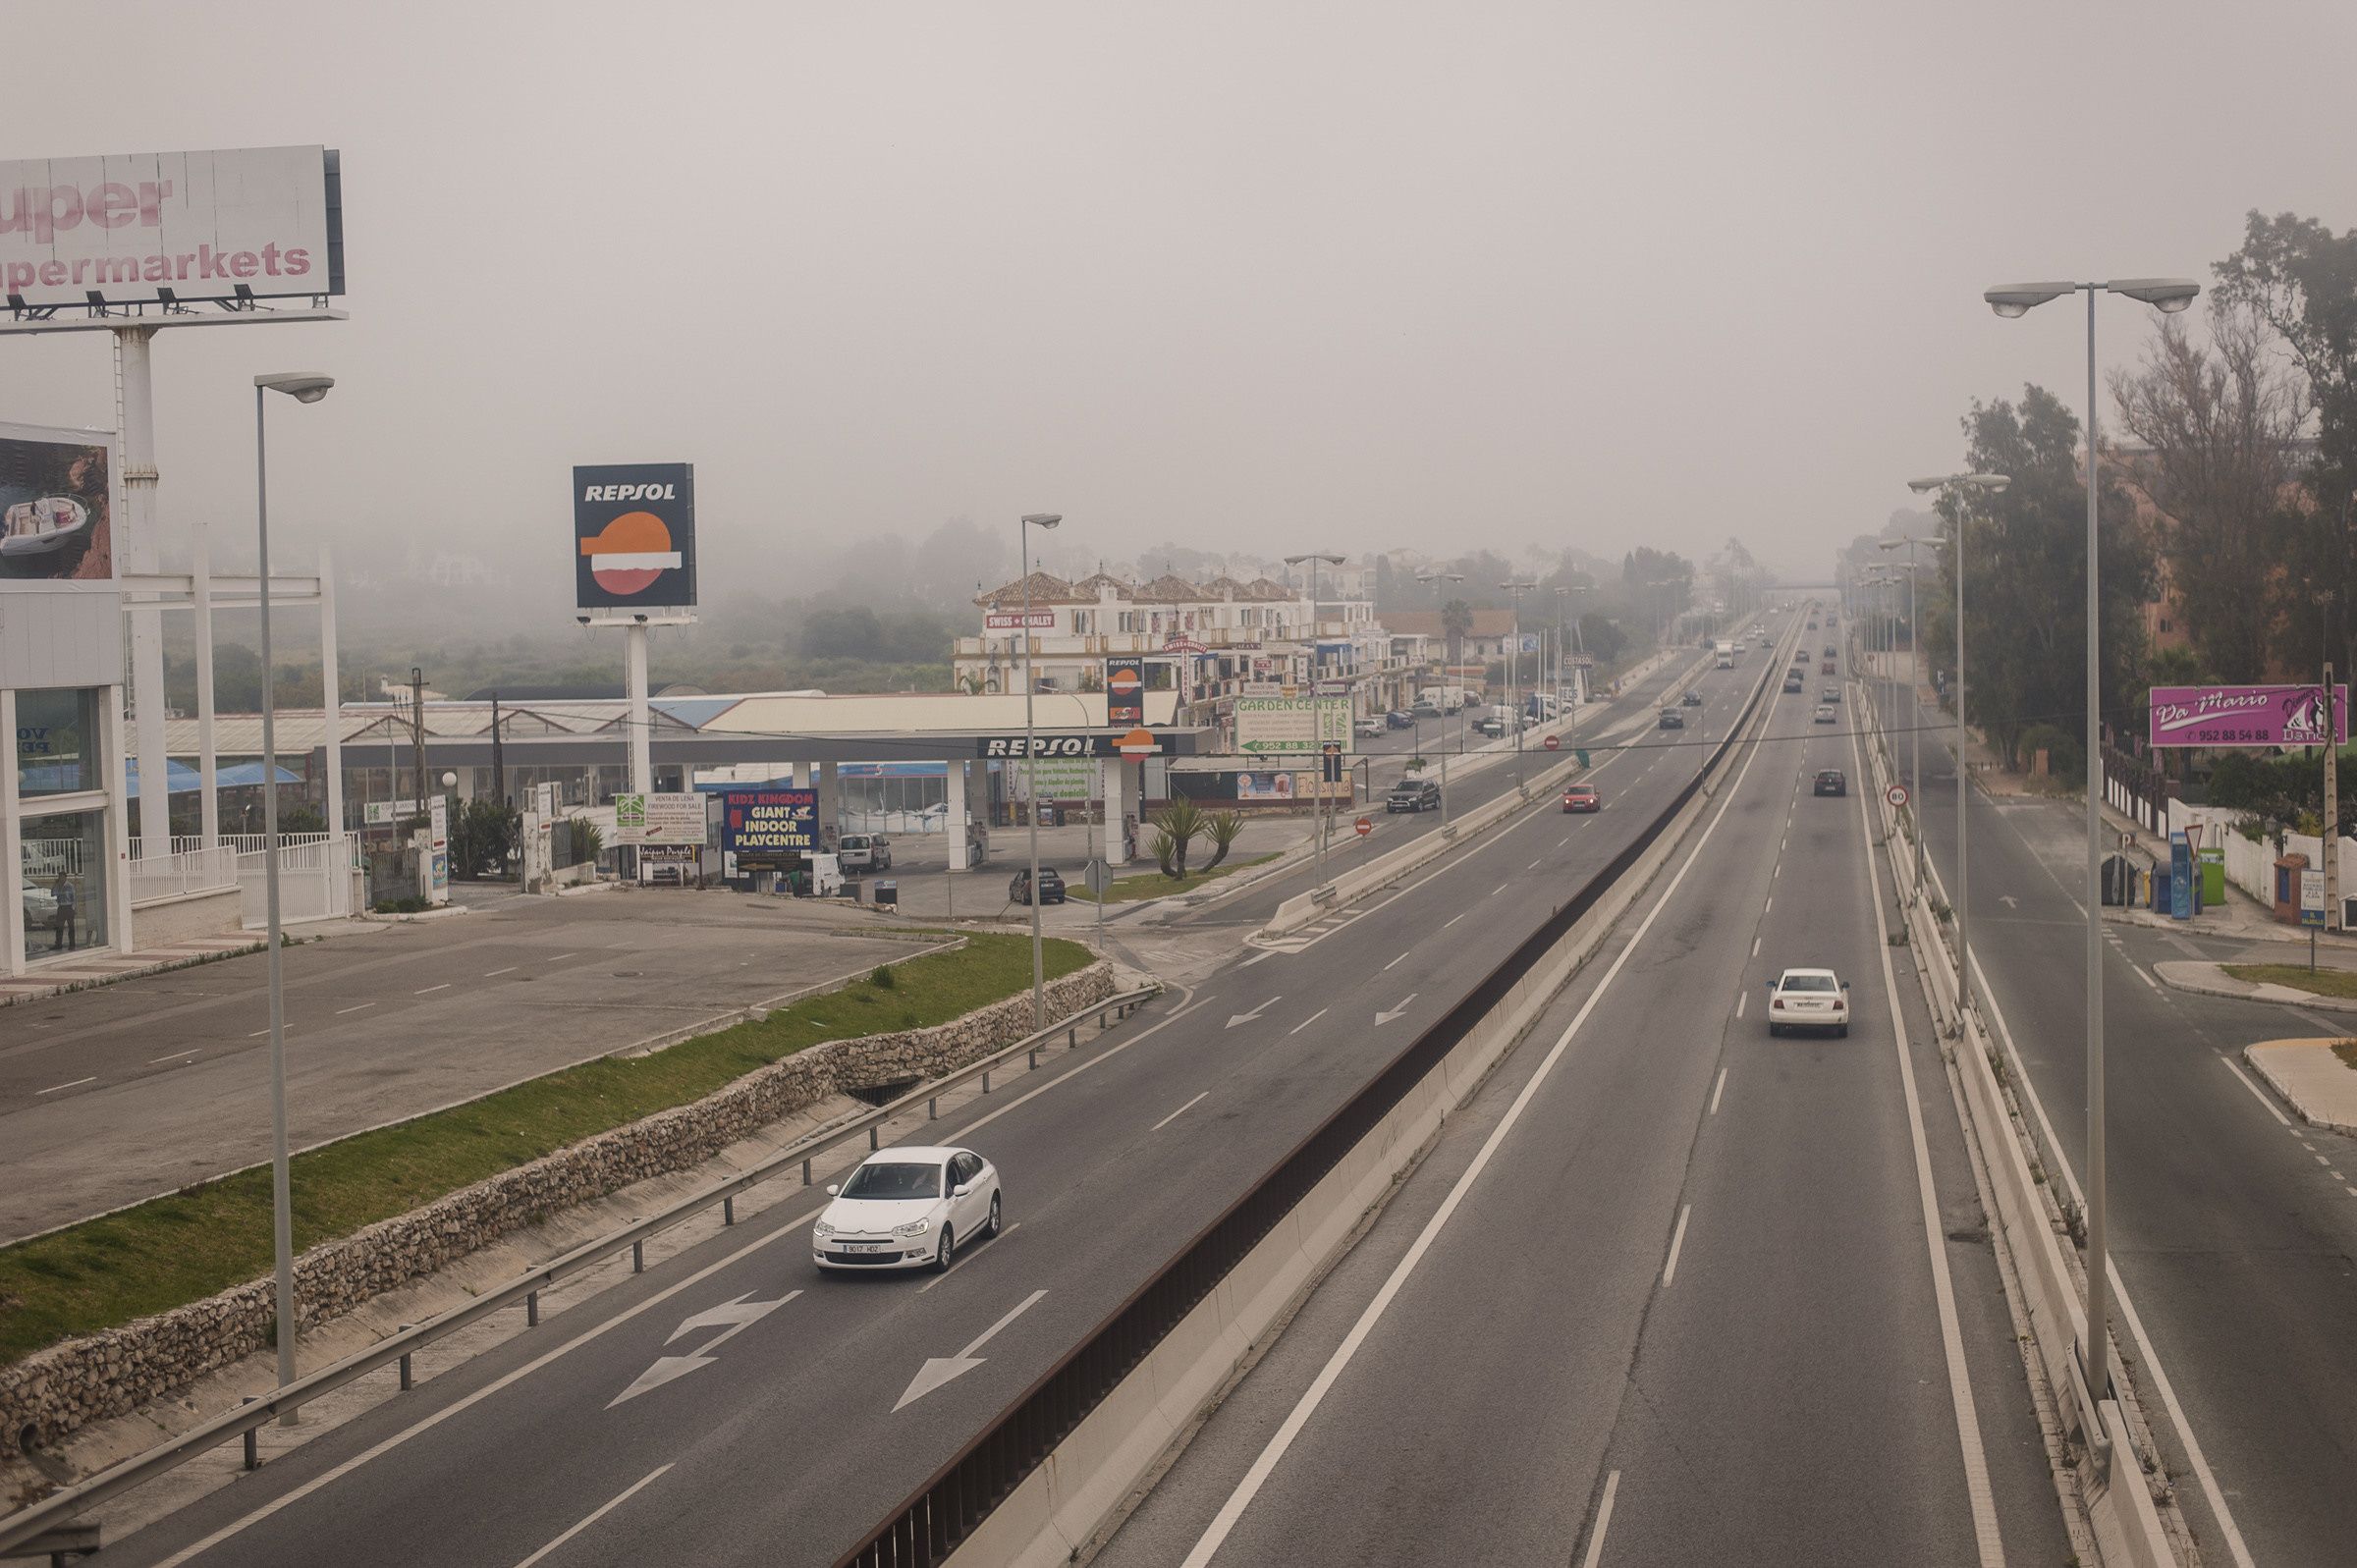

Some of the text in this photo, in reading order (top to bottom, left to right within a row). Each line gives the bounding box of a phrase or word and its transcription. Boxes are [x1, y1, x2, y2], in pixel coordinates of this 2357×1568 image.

[0, 242, 310, 296] permarkets
[584, 484, 676, 502] REPSOL
[989, 617, 1013, 627] SWISS
[1164, 641, 1185, 653] SWISS
[1238, 699, 1349, 712] GARDEN CENTER
[2156, 690, 2269, 724] Da Mario
[2199, 730, 2270, 741] 952 88 54 88
[987, 738, 1097, 757] REPSOL
[728, 793, 814, 805] KIDZ KINGDOM
[751, 806, 792, 819] GIANT
[745, 821, 798, 834] INDOOR
[735, 834, 811, 847] PLAYCENTRE
[2121, 834, 2131, 849] P
[639, 845, 691, 860] Jaipur Purple
